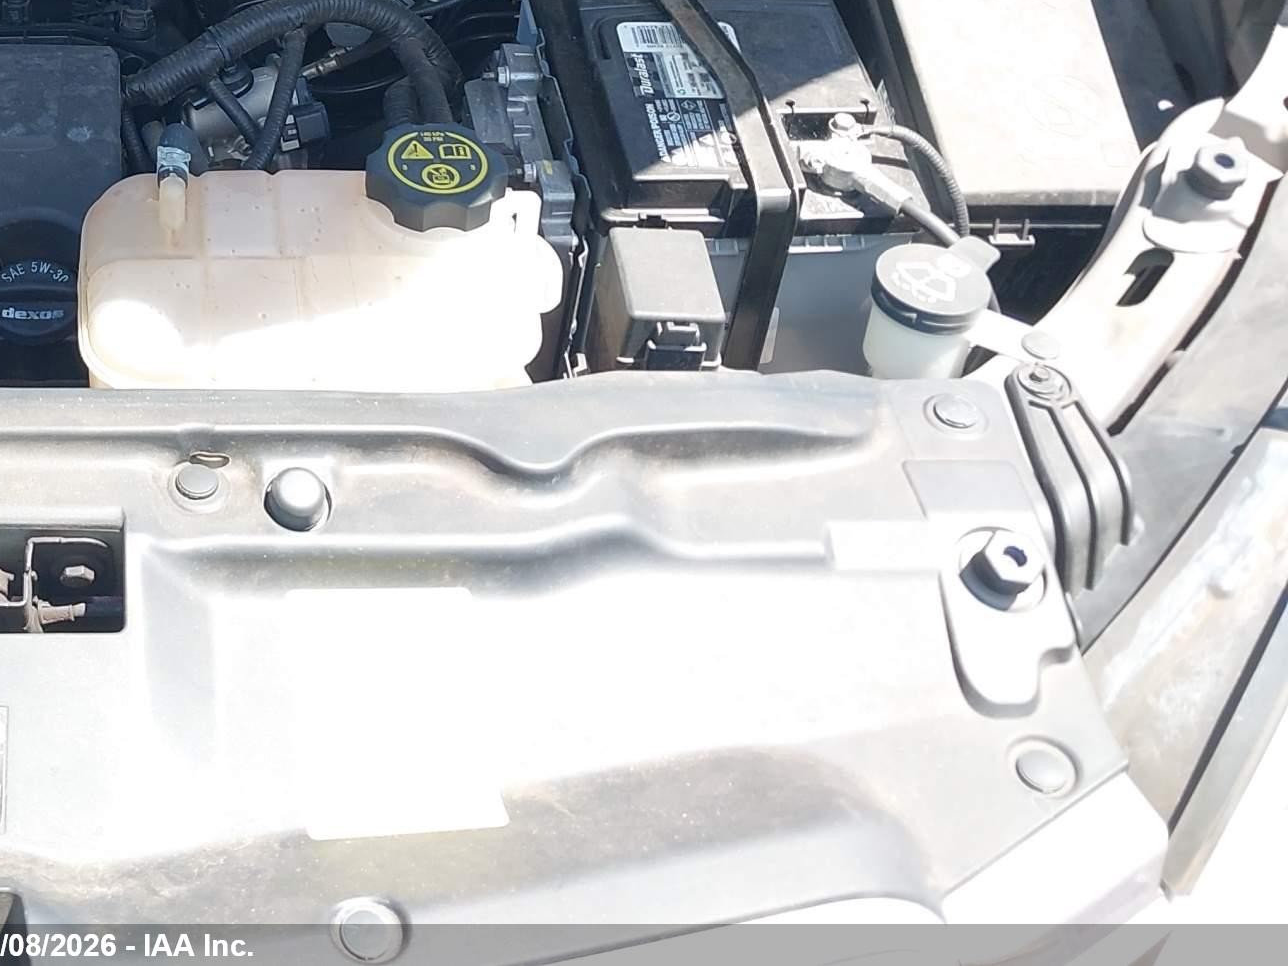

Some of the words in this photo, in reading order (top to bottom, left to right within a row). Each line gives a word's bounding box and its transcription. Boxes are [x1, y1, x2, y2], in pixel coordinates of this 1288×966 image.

[630, 53, 655, 95] Duralast
[1, 263, 25, 282] SAE
[31, 261, 69, 282] 5W-30
[1, 307, 64, 320] dexos
